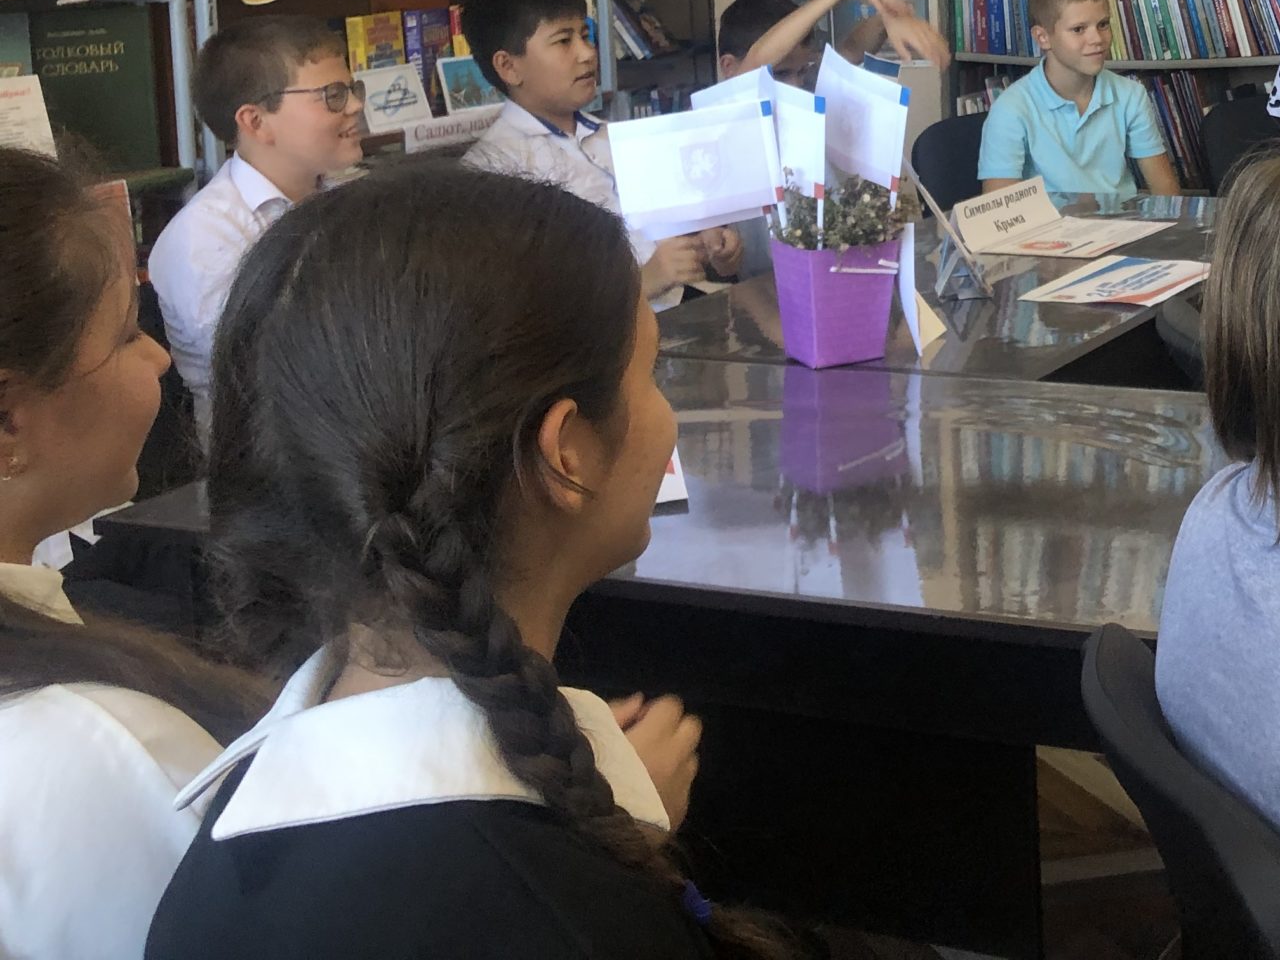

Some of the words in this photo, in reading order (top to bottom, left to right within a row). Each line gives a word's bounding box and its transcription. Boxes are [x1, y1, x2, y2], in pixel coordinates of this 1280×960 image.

[36, 41, 125, 61] ТОЛКОВЫЙ
[42, 59, 119, 77] СЛОВАРЬ
[963, 194, 1004, 219] Символы
[1005, 184, 1038, 209] родного
[993, 213, 1026, 234] Крыма
